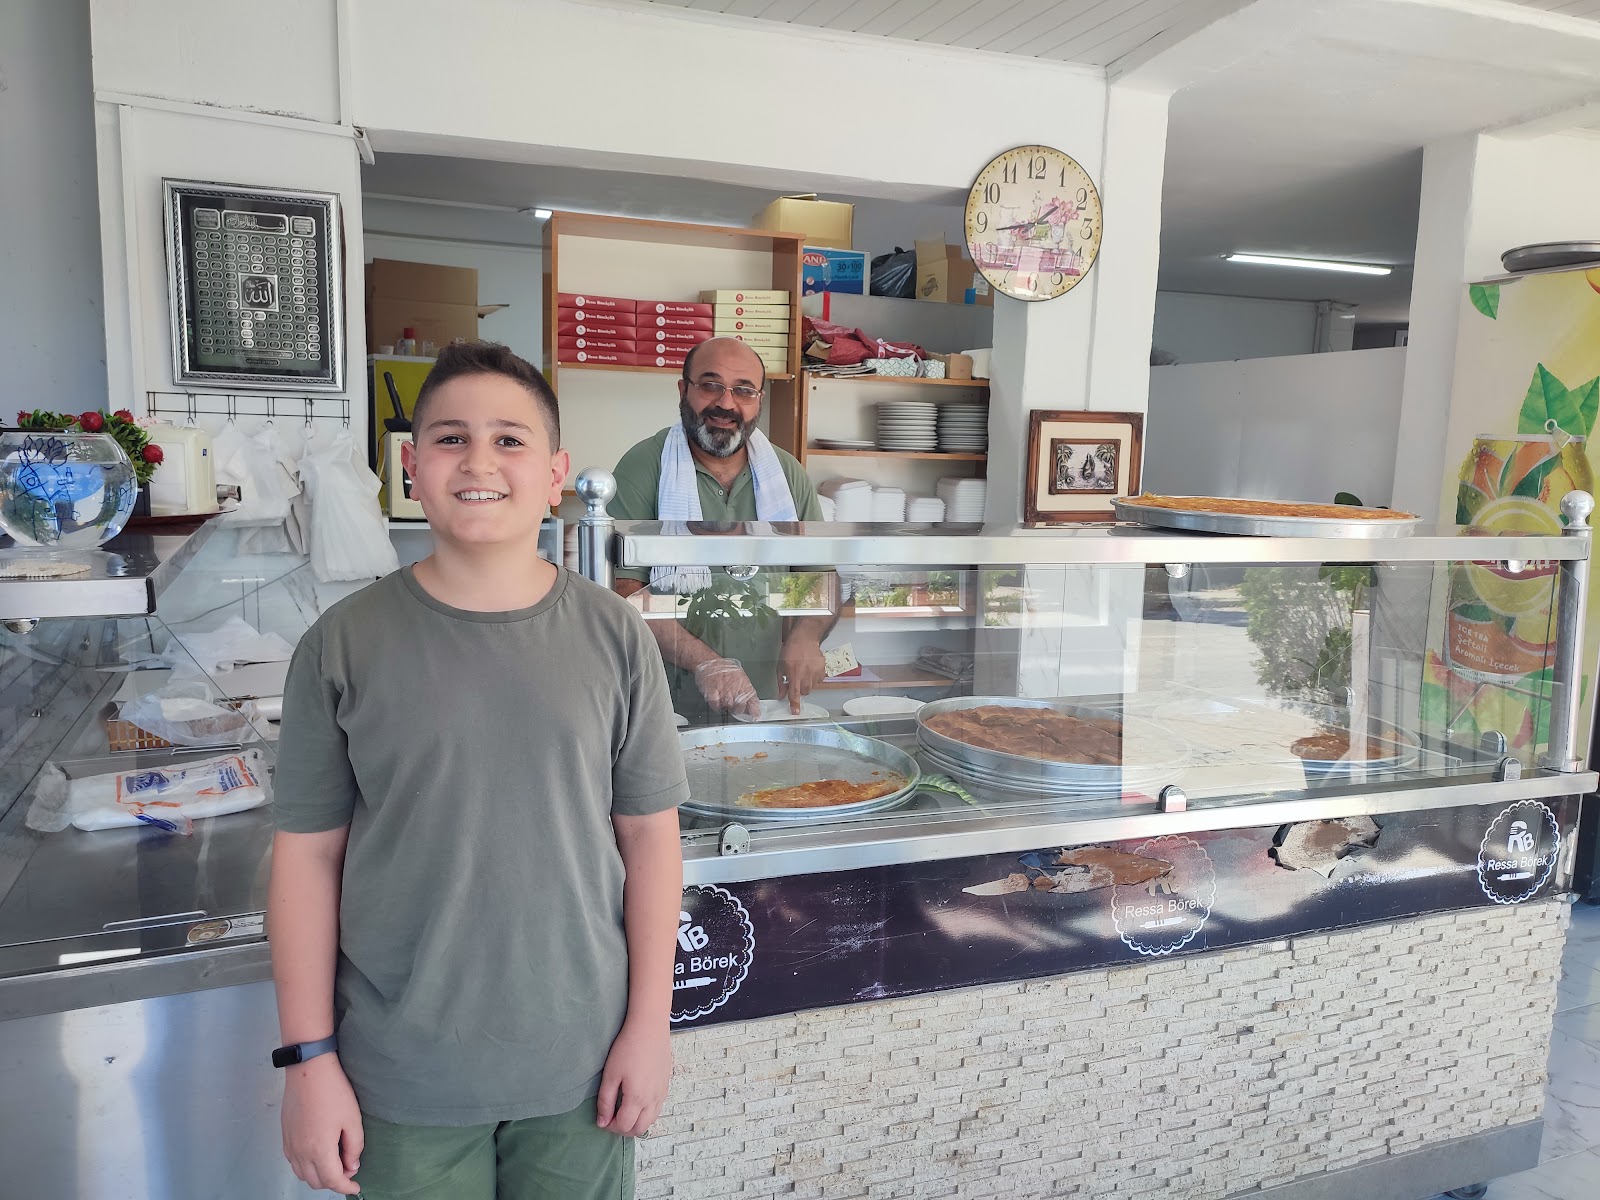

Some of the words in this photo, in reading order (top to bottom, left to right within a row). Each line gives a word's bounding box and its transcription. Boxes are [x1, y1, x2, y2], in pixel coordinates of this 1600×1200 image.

[1003, 161, 1018, 184] 11
[1027, 156, 1047, 180] 12
[1059, 166, 1066, 187] 1
[983, 182, 1001, 204] 10
[1076, 188, 1088, 211] 2
[975, 212, 988, 233] 9
[1080, 218, 1093, 240] 3
[1003, 263, 1013, 284] 7
[1027, 271, 1038, 292] 6
[1051, 267, 1063, 286] 5
[1457, 634, 1489, 653] Şeftali
[1458, 624, 1472, 635] ICE
[1473, 631, 1489, 643] TEA
[1455, 645, 1486, 664] Aromalı
[1488, 657, 1520, 672] İçecek
[1487, 858, 1518, 872] Ressa
[1520, 855, 1548, 867] Börek
[1125, 903, 1164, 919] Ressa
[1168, 896, 1203, 912] Börek
[690, 952, 738, 973] Börek
